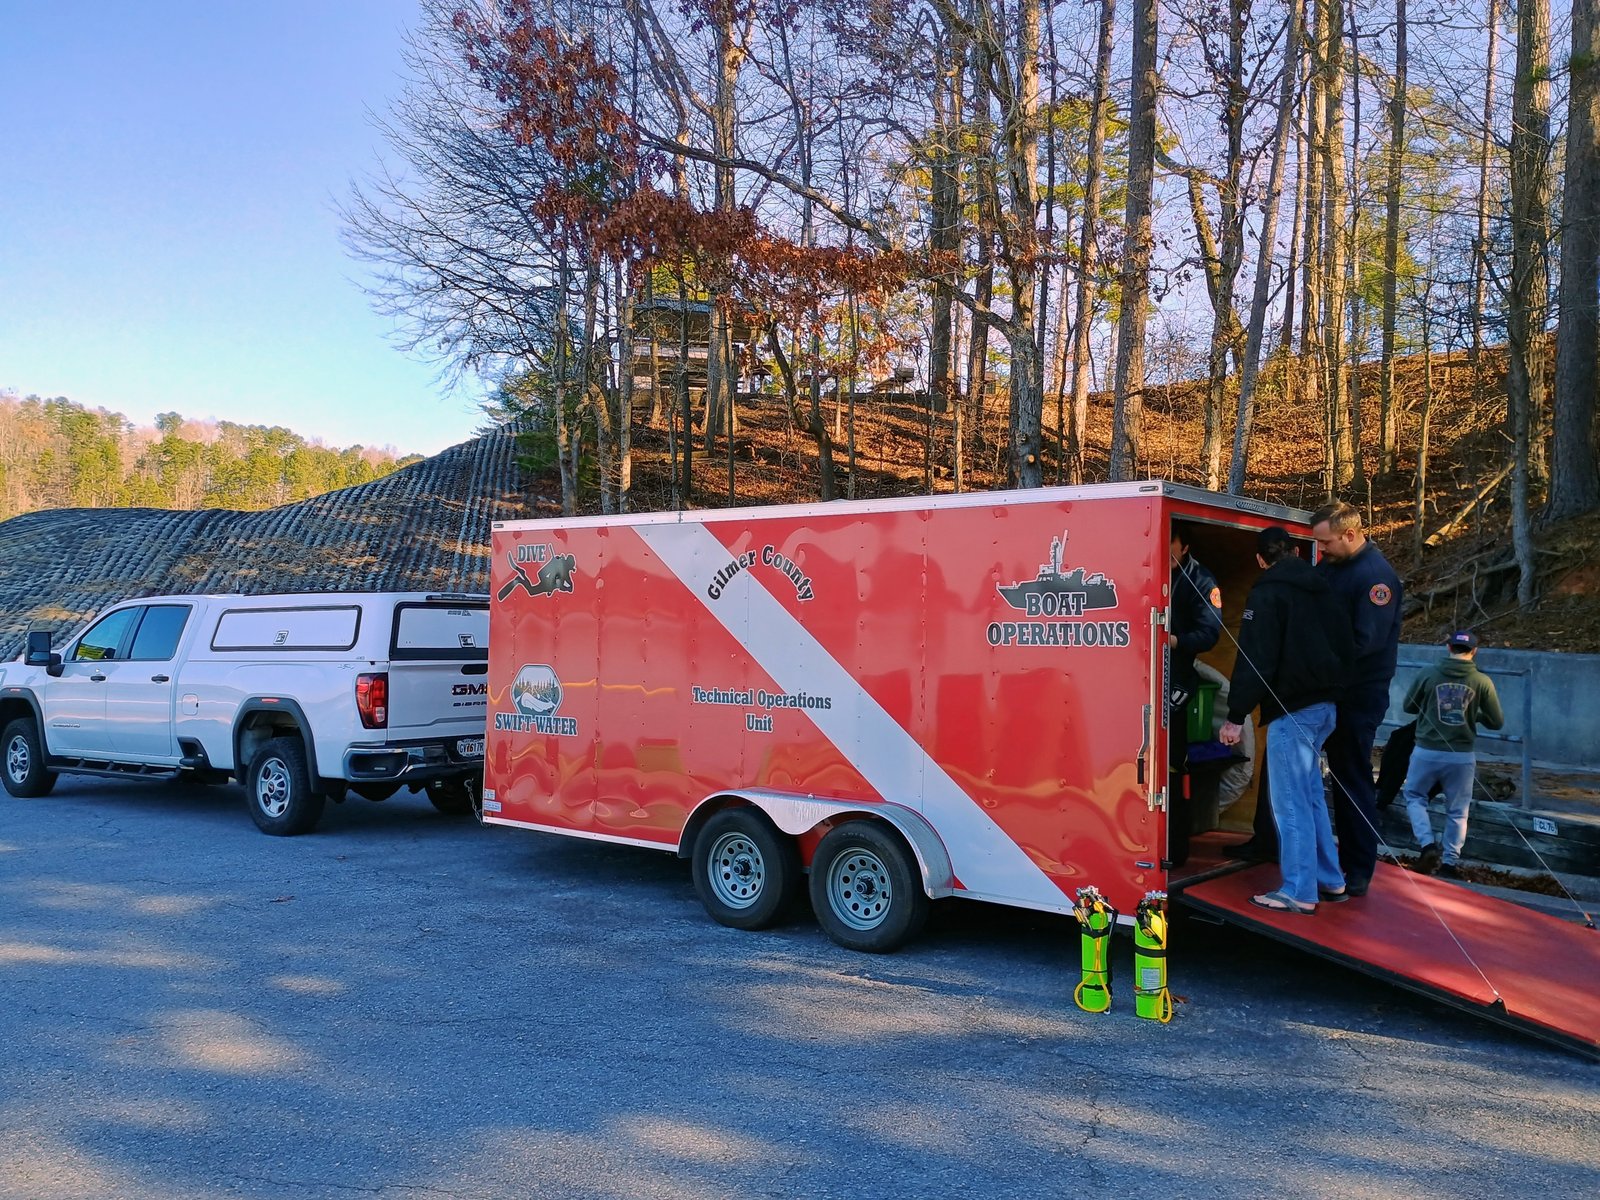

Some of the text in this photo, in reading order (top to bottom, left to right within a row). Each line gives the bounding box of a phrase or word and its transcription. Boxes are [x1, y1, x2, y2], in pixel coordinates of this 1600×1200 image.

[518, 545, 546, 562] DIVE
[707, 545, 814, 601] Gilmer County
[1026, 593, 1086, 616] BOAT
[987, 622, 1129, 646] OPERATIONS
[452, 683, 488, 695] GM
[692, 687, 832, 710] Technical Operations
[746, 714, 773, 732] Unit
